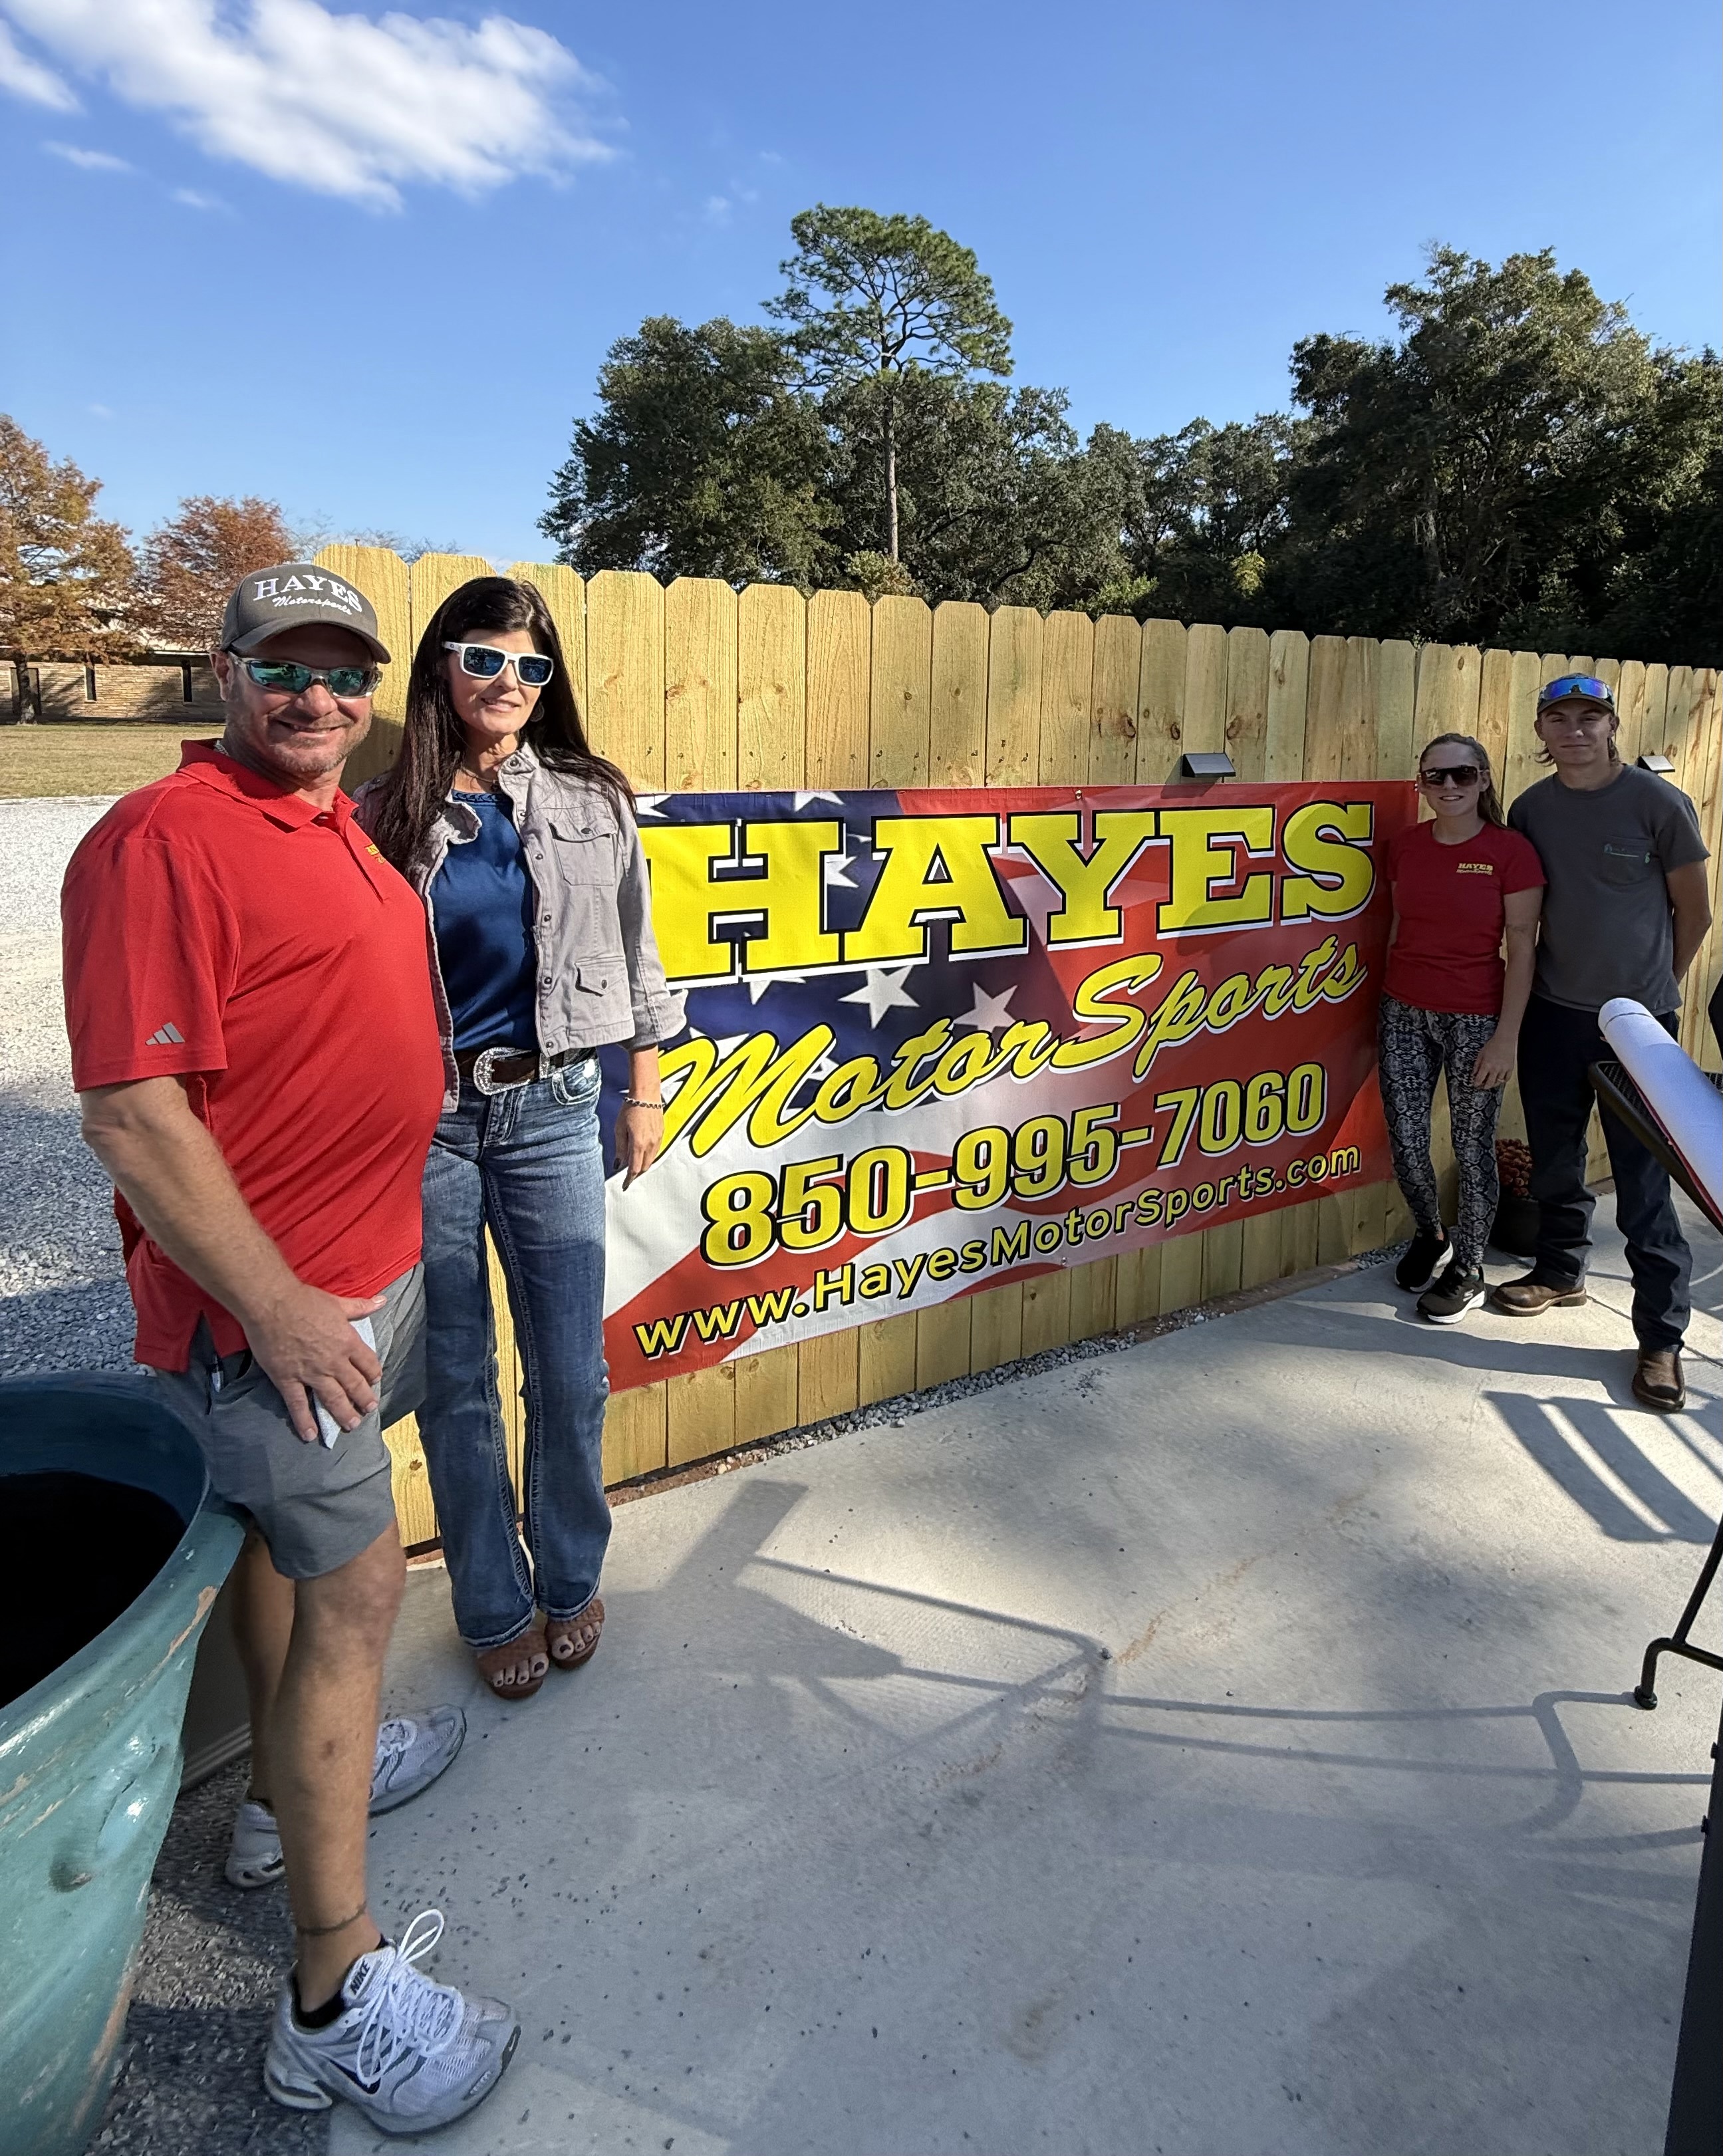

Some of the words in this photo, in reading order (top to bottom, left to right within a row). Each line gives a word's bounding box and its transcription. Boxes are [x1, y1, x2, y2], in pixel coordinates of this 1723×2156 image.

[253, 575, 362, 612] HAYES
[272, 595, 352, 615] Motorsports
[636, 800, 1375, 986] HAYES
[656, 934, 1368, 1162] MotorSports
[632, 1143, 1362, 1359] www.HayesMotorSports.com
[700, 1061, 1327, 1268] 850-995-7060
[350, 1960, 370, 1995] NIKE
